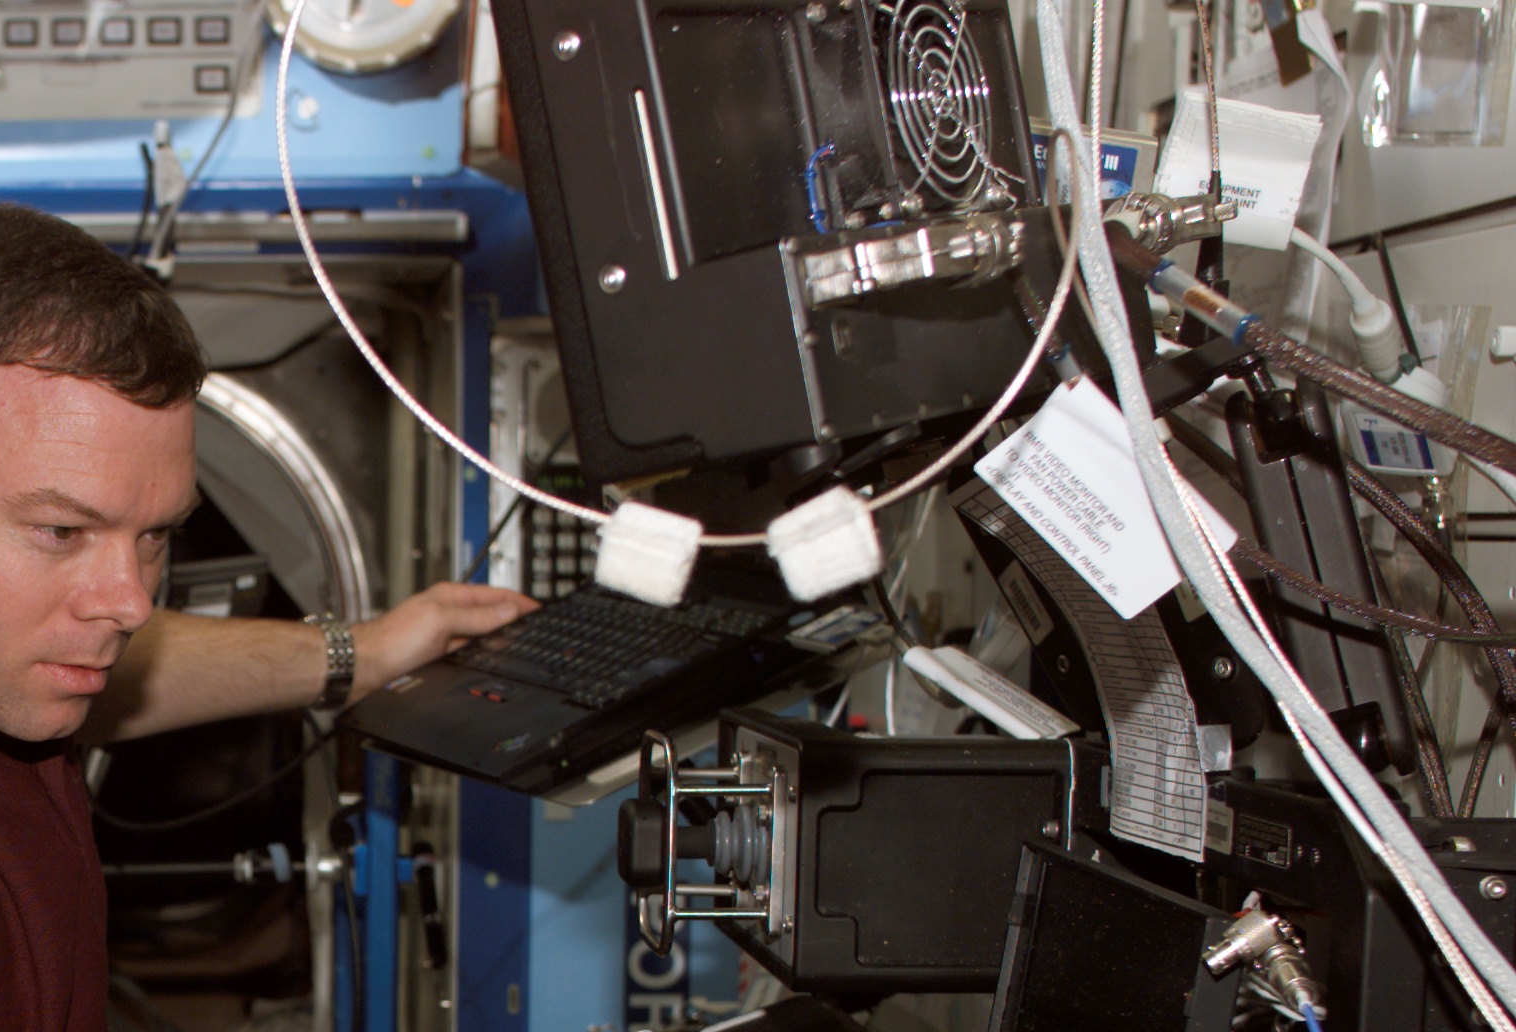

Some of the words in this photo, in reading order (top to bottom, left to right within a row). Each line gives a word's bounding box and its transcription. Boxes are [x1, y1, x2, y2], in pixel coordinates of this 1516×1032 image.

[1198, 180, 1262, 198] EQIPMENT
[1006, 448, 1019, 463] TO
[1017, 459, 1045, 487] VIDEO
[1042, 484, 1082, 524] MONITOR
[1077, 522, 1111, 554] (RIGHT)
[1024, 431, 1045, 453] RMS
[1043, 453, 1071, 478] VIDEO
[1067, 475, 1108, 516] MONITOR
[1104, 513, 1125, 532] AND
[1028, 453, 1049, 474] FAN
[1045, 470, 1079, 503] POWER
[1075, 501, 1105, 528] CABLE
[1021, 501, 1044, 519] AND
[1039, 518, 1080, 556] CONTROL
[1077, 555, 1106, 582] PANEL
